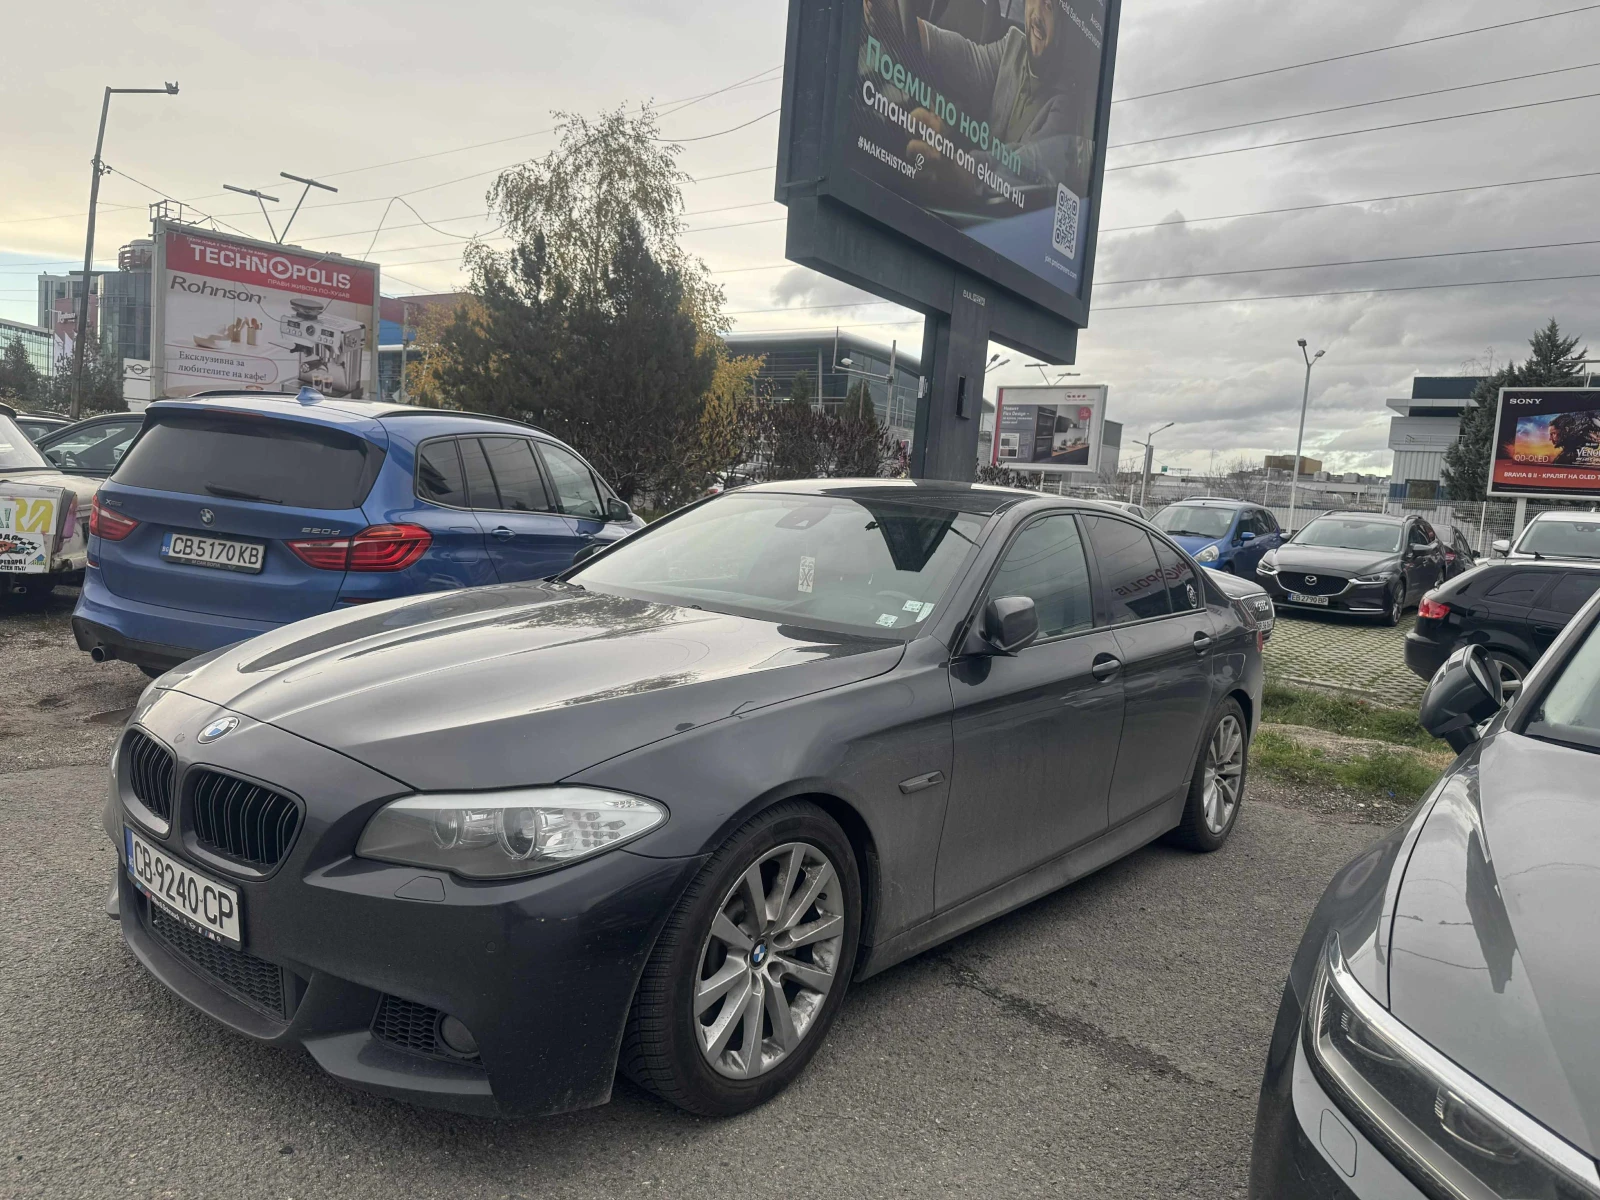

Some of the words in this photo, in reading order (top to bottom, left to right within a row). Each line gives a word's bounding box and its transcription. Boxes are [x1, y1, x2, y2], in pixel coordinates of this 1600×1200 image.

[866, 34, 931, 109] Поеми
[935, 92, 957, 127] по
[960, 112, 990, 151] нов
[991, 136, 1022, 176] път
[862, 80, 916, 135] Стани
[918, 123, 955, 161] част
[956, 148, 975, 175] от
[977, 162, 1011, 199] екипа
[1012, 186, 1026, 210] ни
[190, 243, 351, 290] TECHNOPOLIS
[170, 275, 262, 304] Rohnson
[267, 279, 290, 288] ПРАВИ
[291, 283, 318, 293] ЖИВОТА
[179, 350, 234, 368] Ексклузивна
[236, 359, 245, 367] за
[178, 364, 231, 378] любителите
[232, 370, 243, 378] на
[244, 371, 267, 382] кафе!
[1514, 454, 1549, 463] QD-OLED
[1576, 446, 1600, 457] VENO
